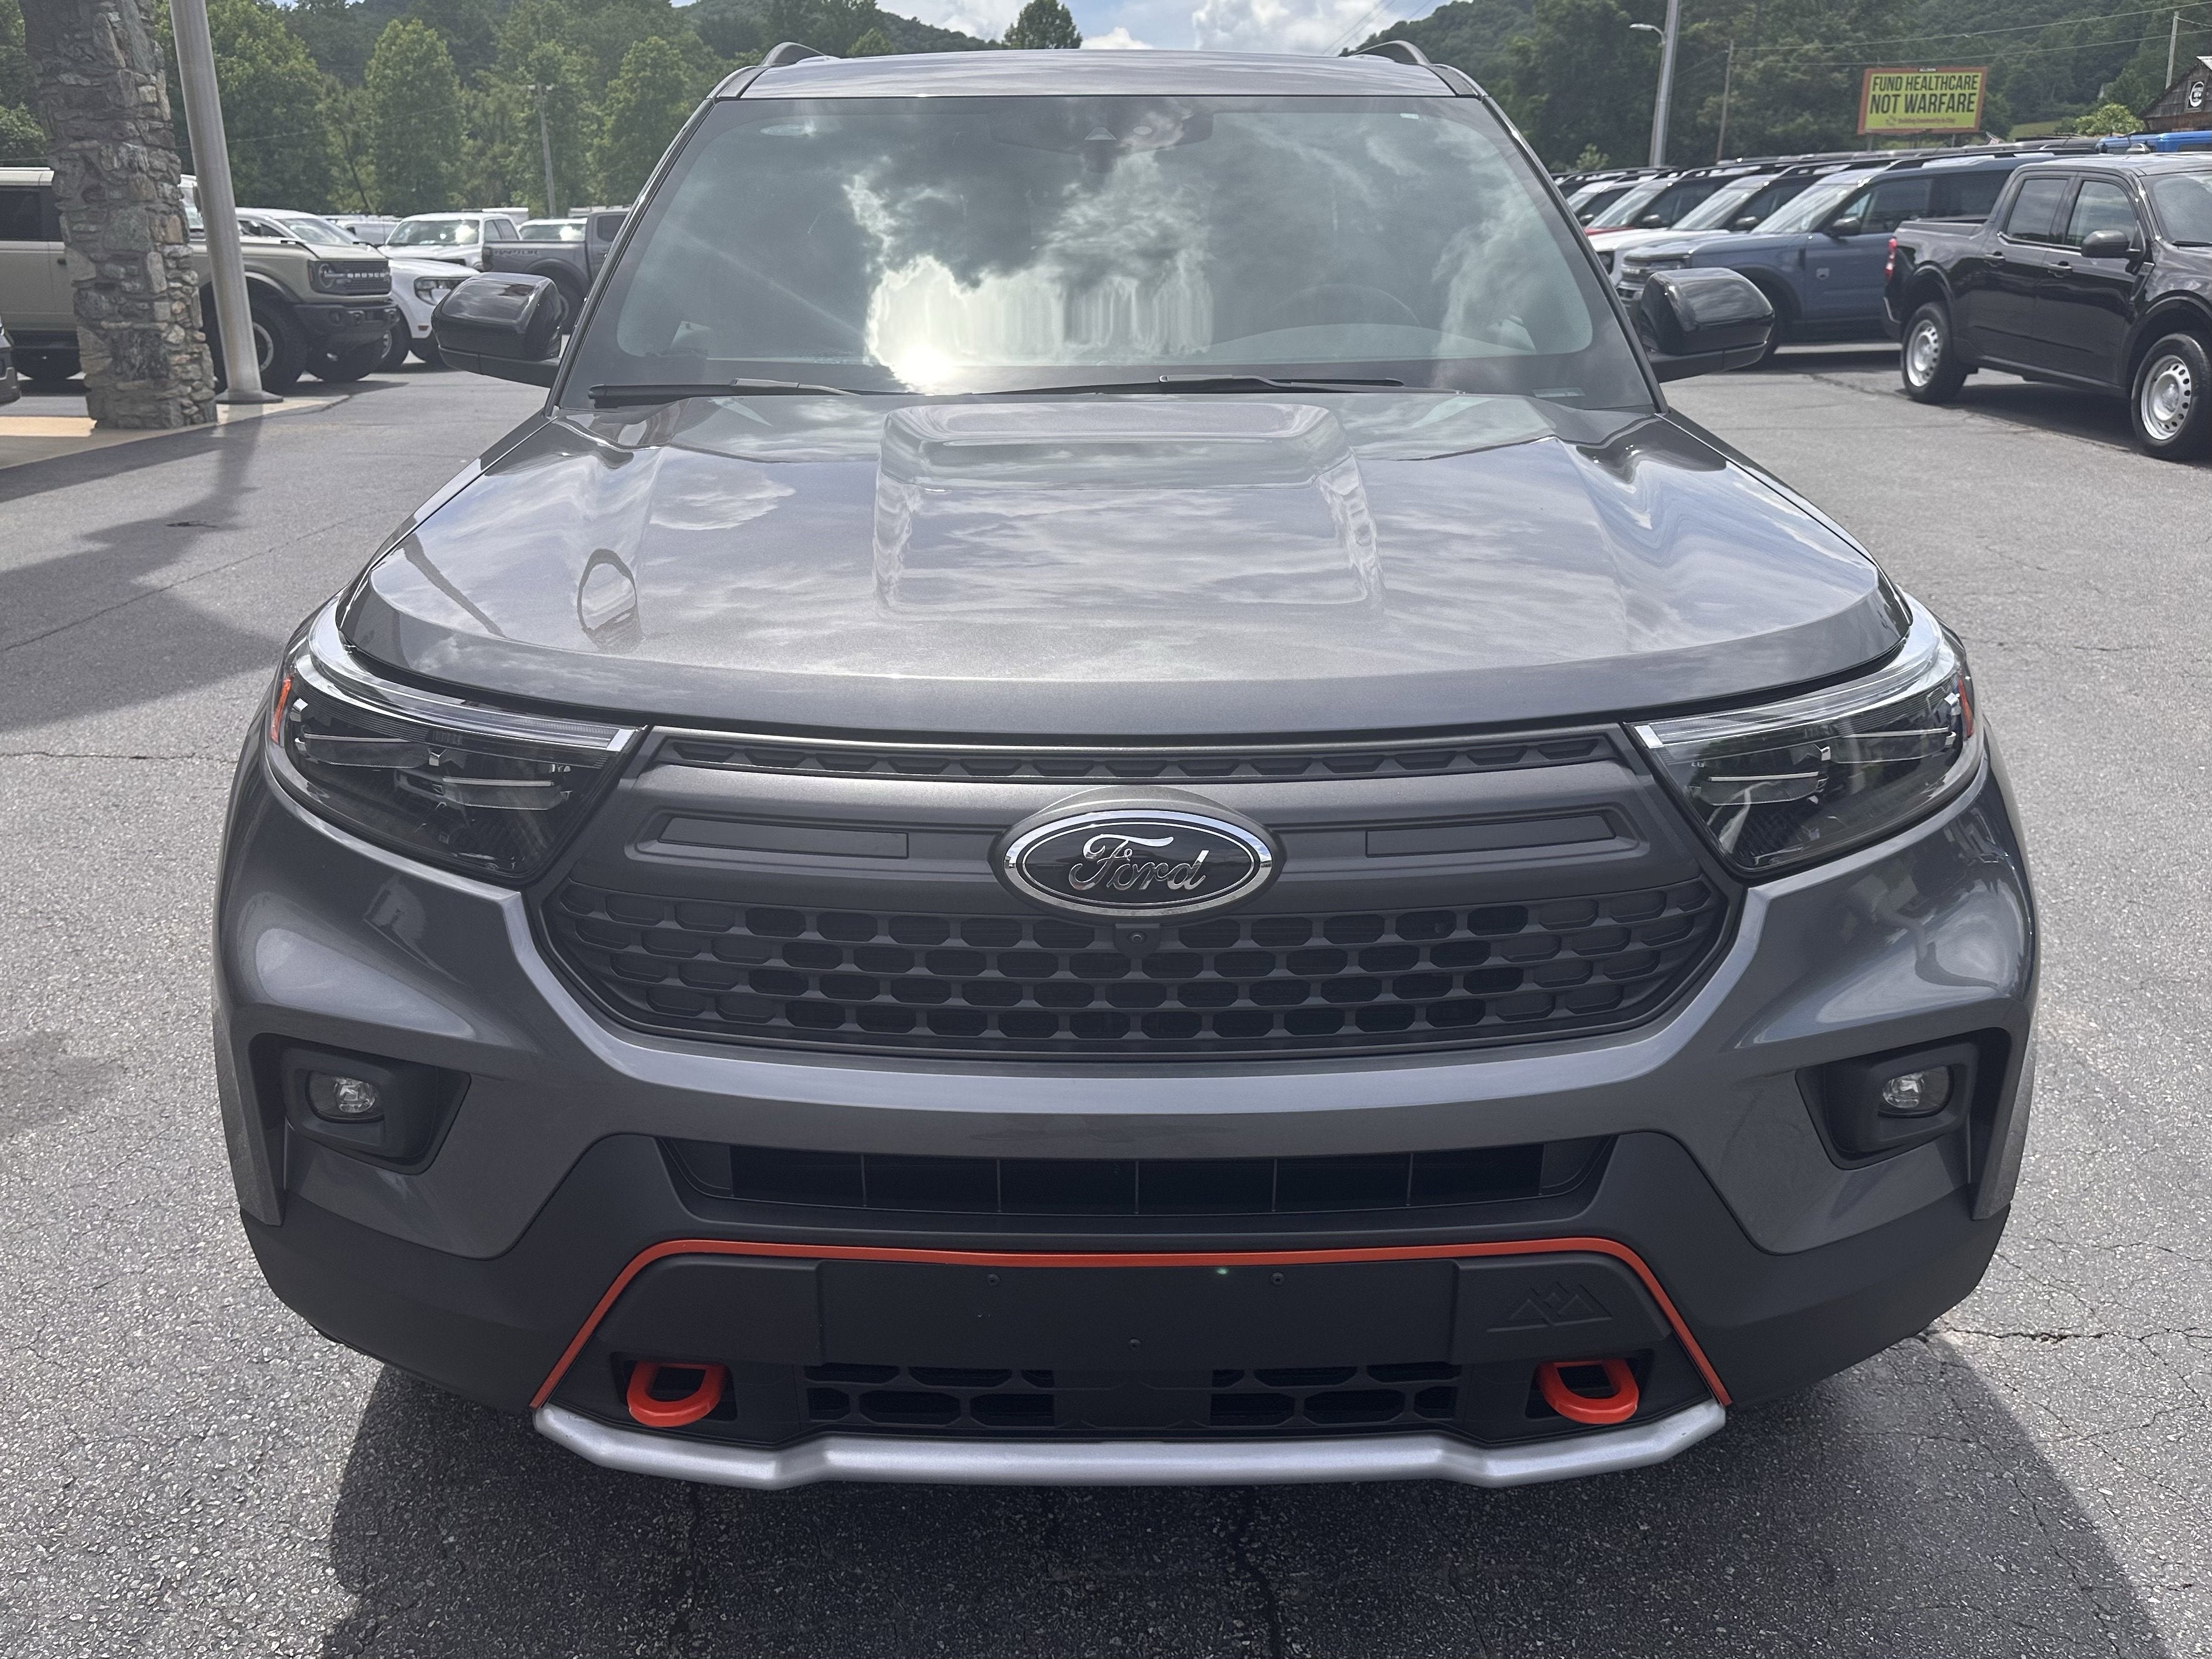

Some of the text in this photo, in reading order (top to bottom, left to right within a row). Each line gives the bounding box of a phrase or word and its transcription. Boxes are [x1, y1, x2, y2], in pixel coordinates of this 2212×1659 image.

[1872, 75, 1979, 91] FUND HEALTHCARE
[1870, 93, 1977, 114] NOT WARFARE
[1068, 834, 1210, 890] Ford
